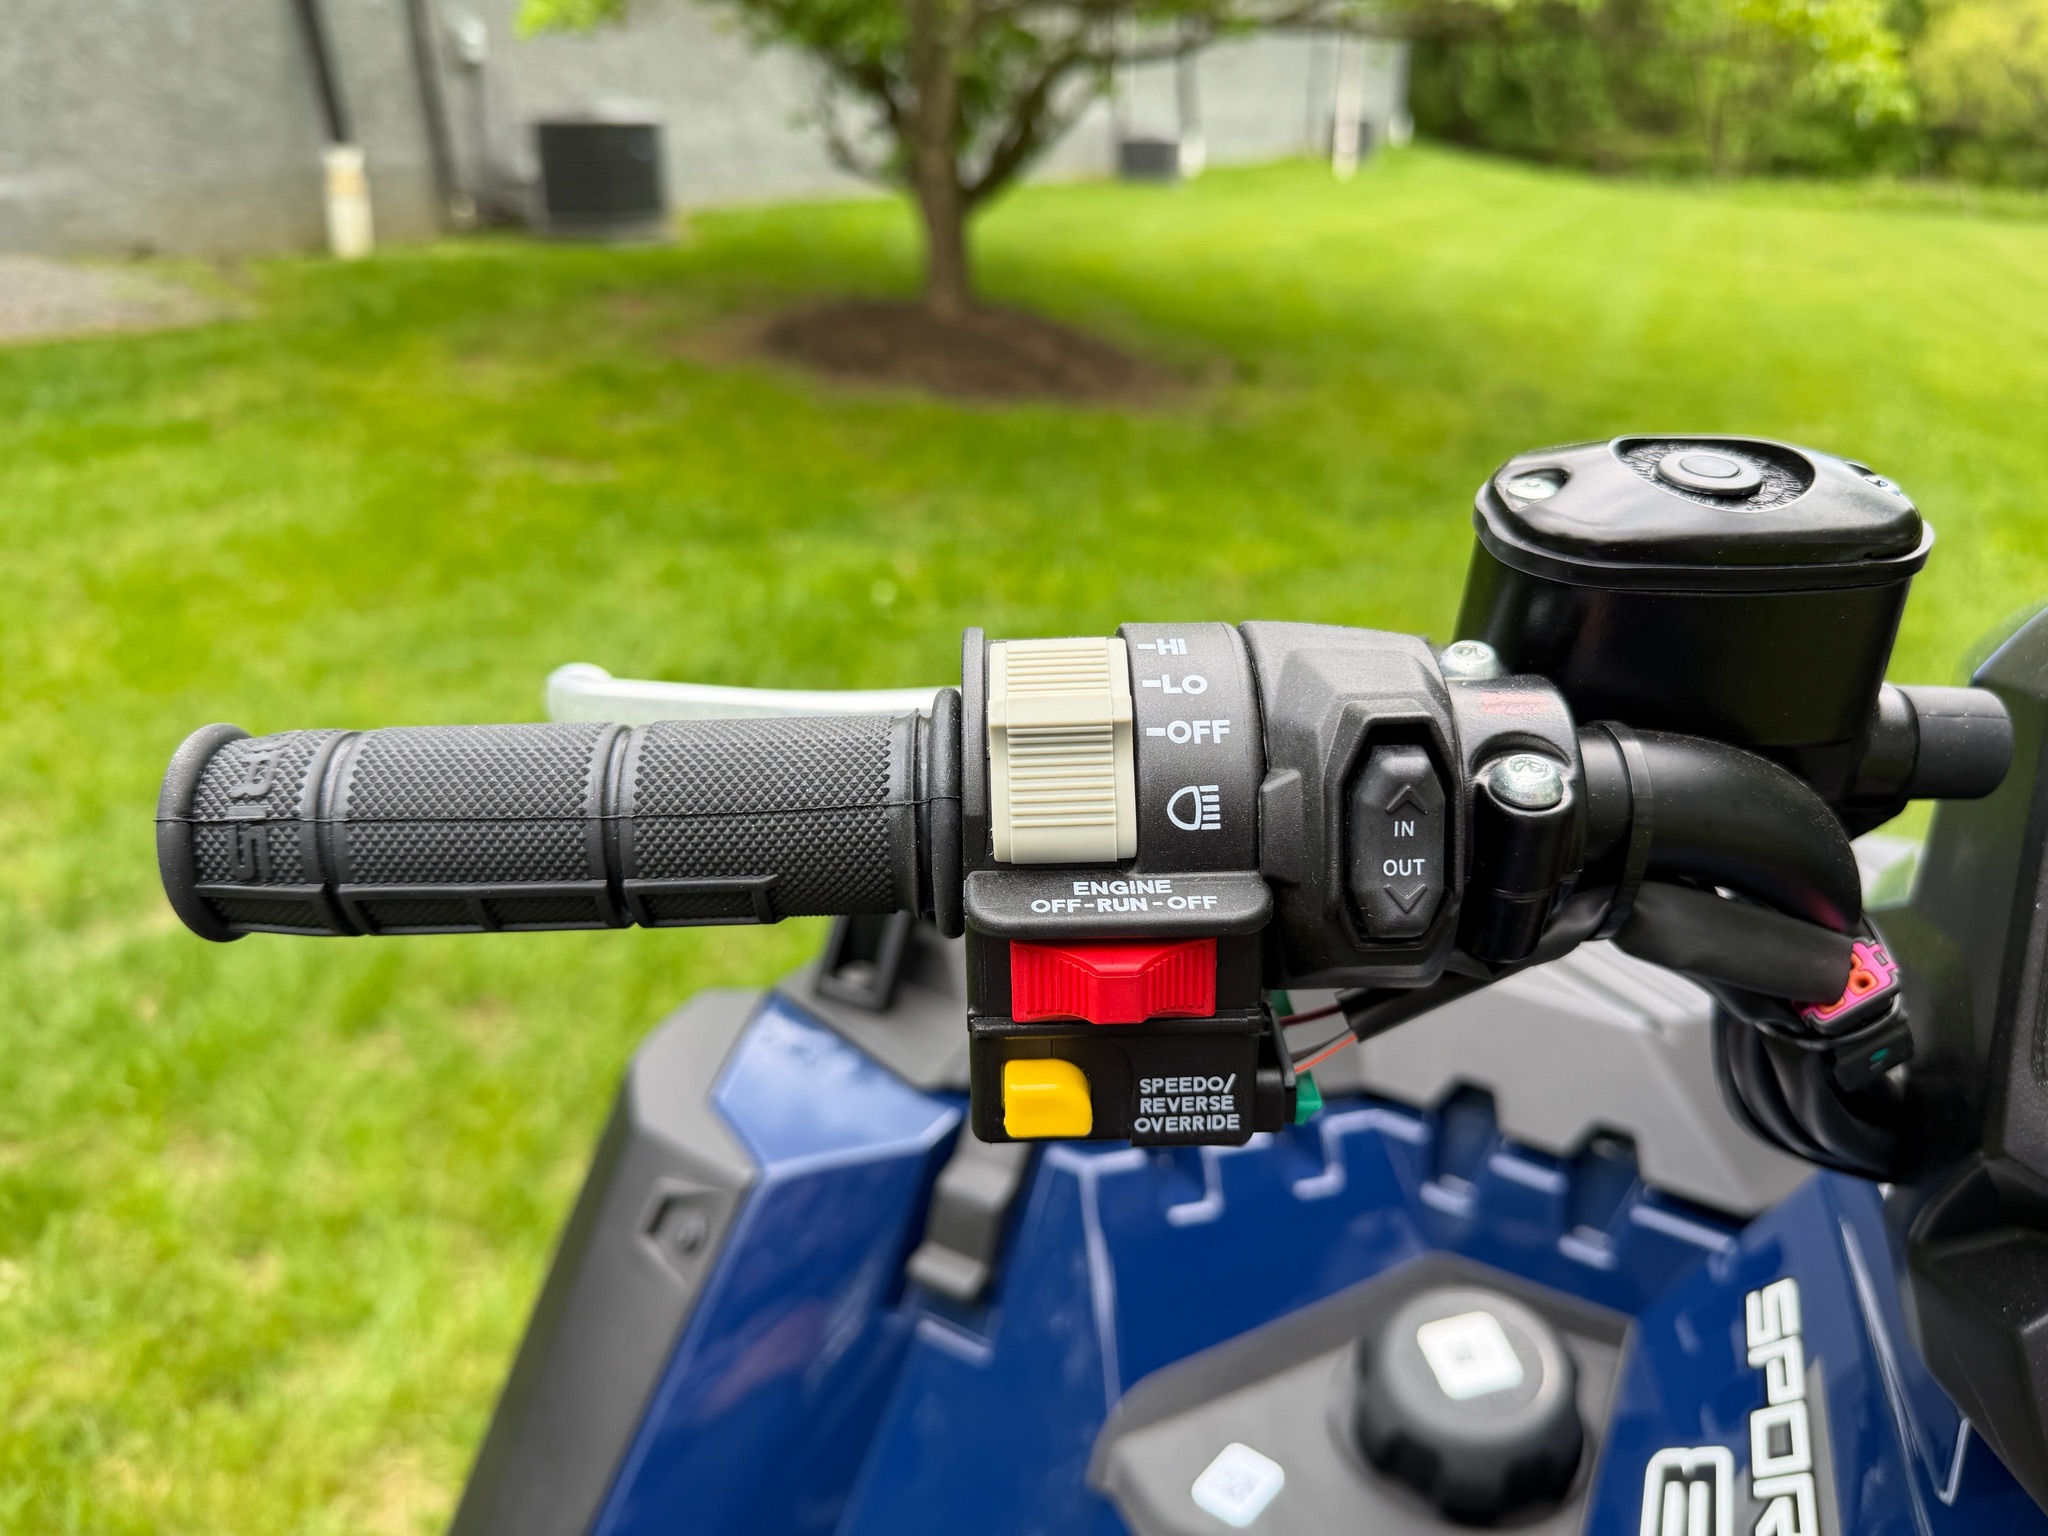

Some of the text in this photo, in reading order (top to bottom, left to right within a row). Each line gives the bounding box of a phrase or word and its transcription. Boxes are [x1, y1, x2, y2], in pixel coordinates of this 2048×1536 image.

[1394, 821, 1414, 837] IN
[1383, 859, 1425, 876] OUT
[1073, 879, 1172, 896] ENGINE
[1140, 1073, 1236, 1094] SPEEDO/
[1140, 1095, 1234, 1114] REVERSE
[1134, 1114, 1240, 1133] OVERRIDE
